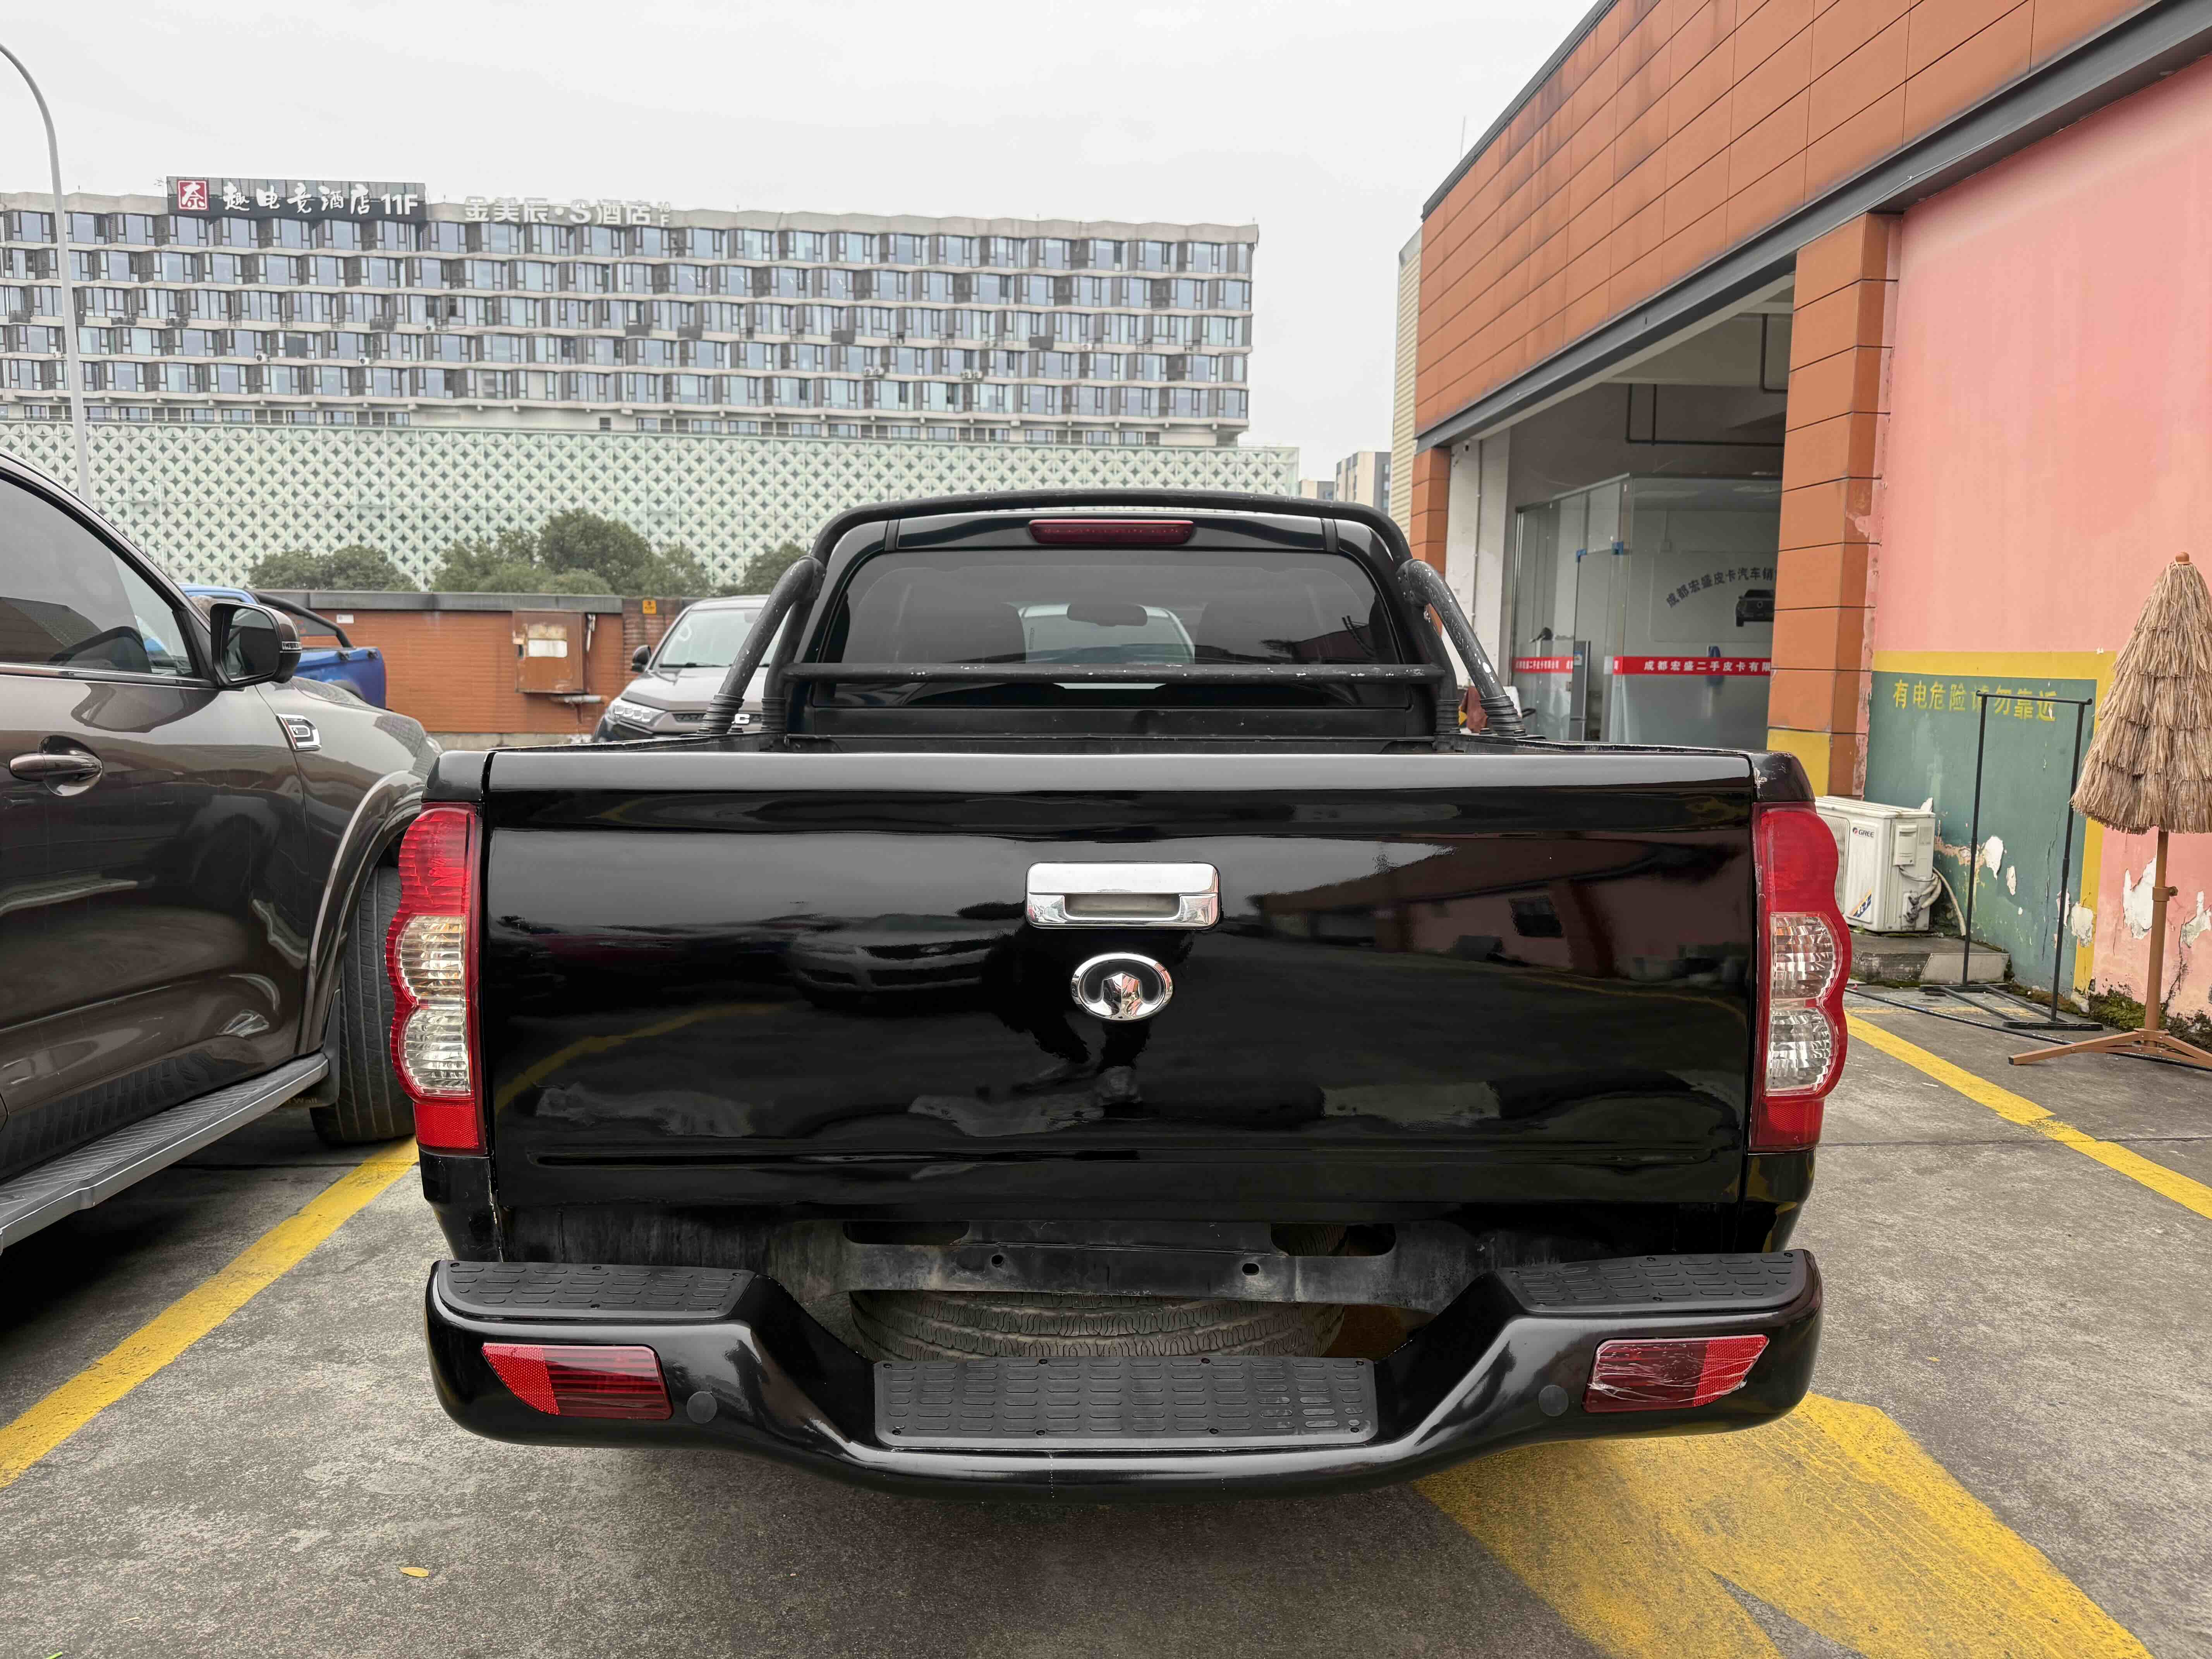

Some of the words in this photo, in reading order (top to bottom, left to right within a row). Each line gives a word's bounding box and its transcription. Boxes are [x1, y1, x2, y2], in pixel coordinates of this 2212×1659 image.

[381, 193, 418, 215] 11F
[1666, 567, 1777, 608] 成都宏盛皮卡汽车销
[1858, 829, 1874, 838] GREE
